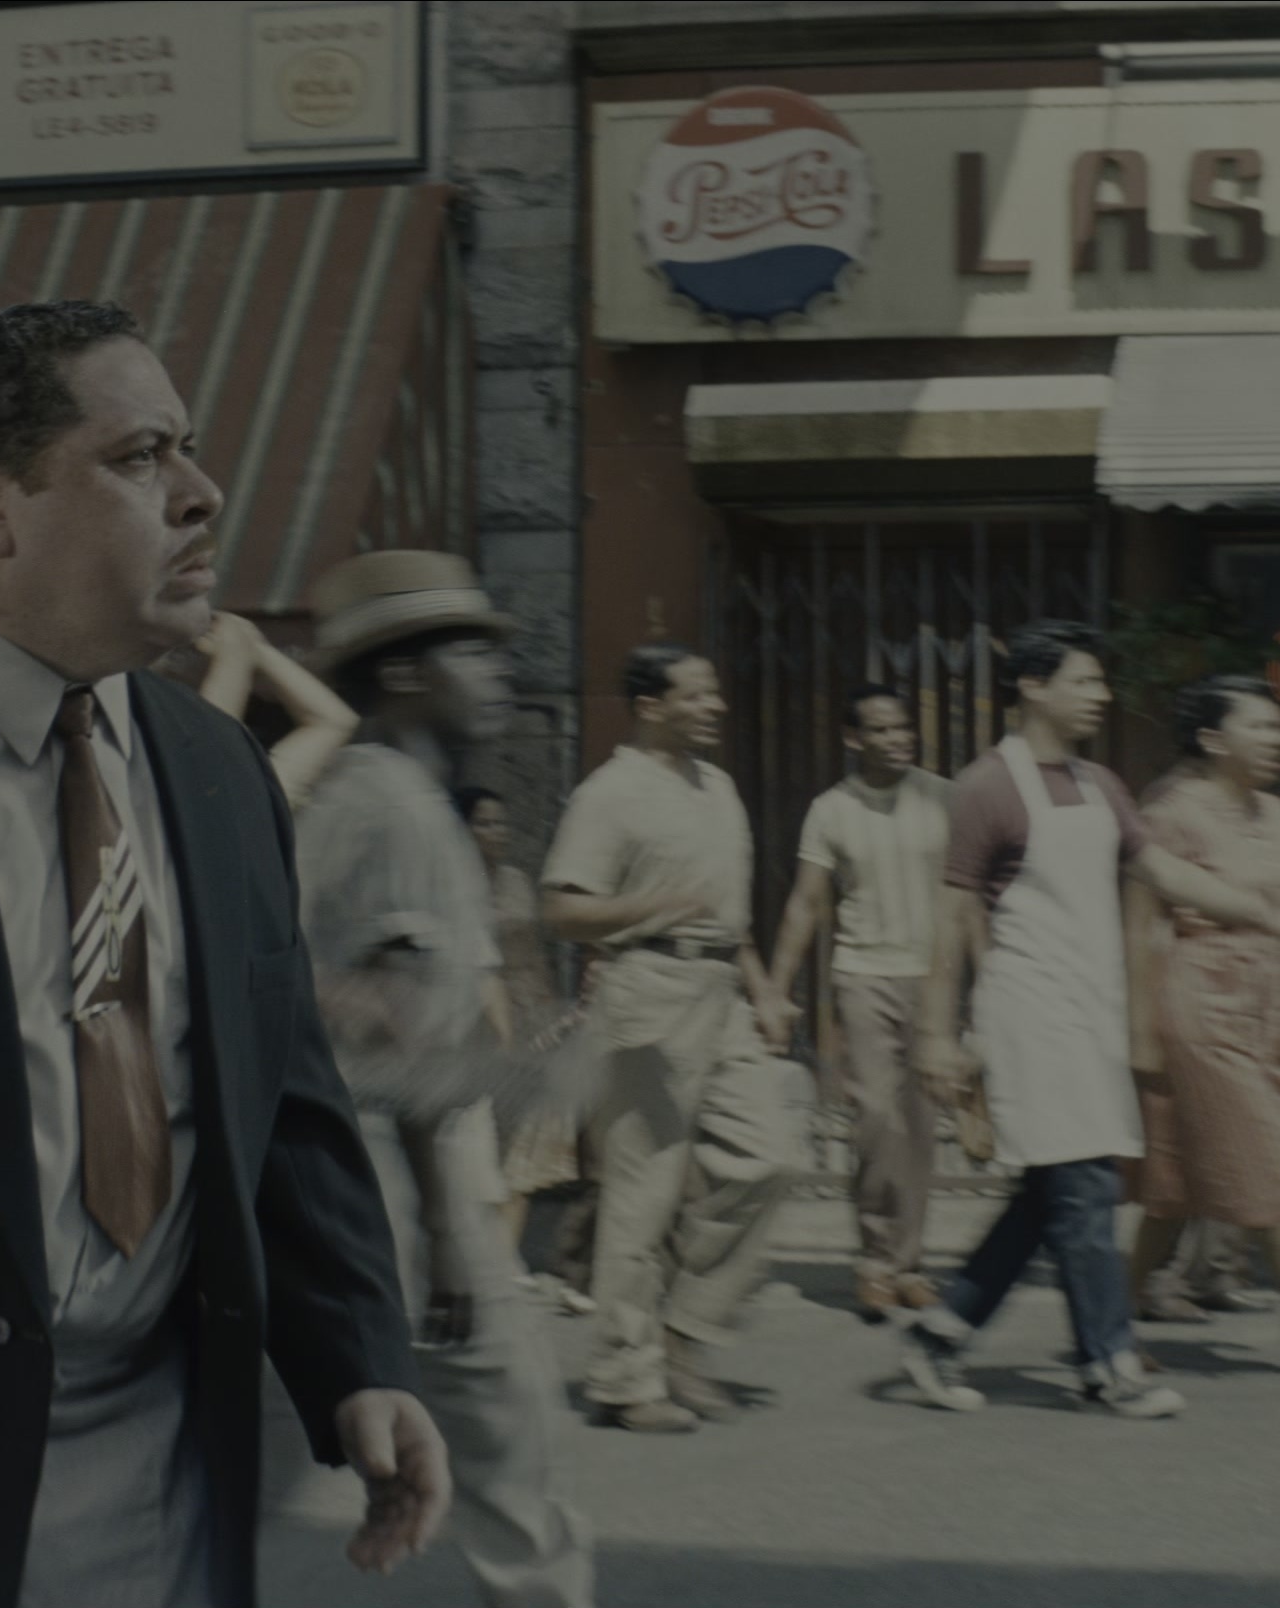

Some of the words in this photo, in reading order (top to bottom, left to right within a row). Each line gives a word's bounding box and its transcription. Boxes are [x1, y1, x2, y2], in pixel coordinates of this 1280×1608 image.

[18, 35, 176, 69] ENTREGA
[16, 72, 175, 104] GRATUITA
[956, 148, 1266, 274] LAS
